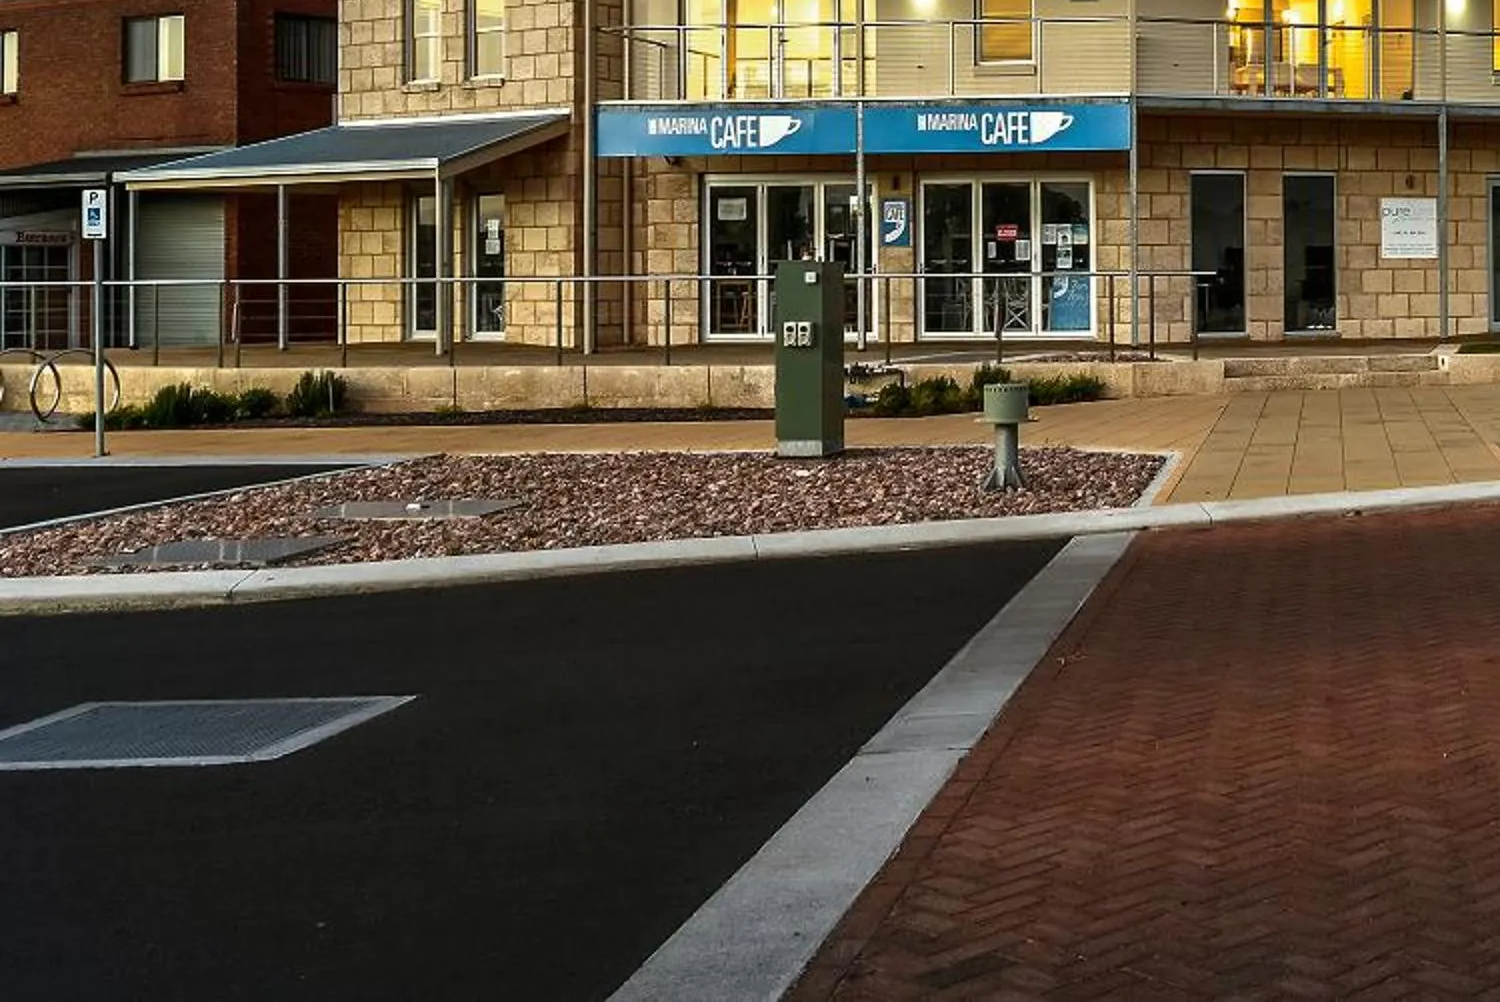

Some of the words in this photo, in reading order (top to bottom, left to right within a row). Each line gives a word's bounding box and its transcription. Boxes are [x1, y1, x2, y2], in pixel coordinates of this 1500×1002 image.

[657, 117, 707, 135] MARINA
[711, 115, 757, 149] CAFE
[927, 113, 978, 131] MARINA
[981, 111, 1029, 145] CAFE
[89, 191, 99, 204] P
